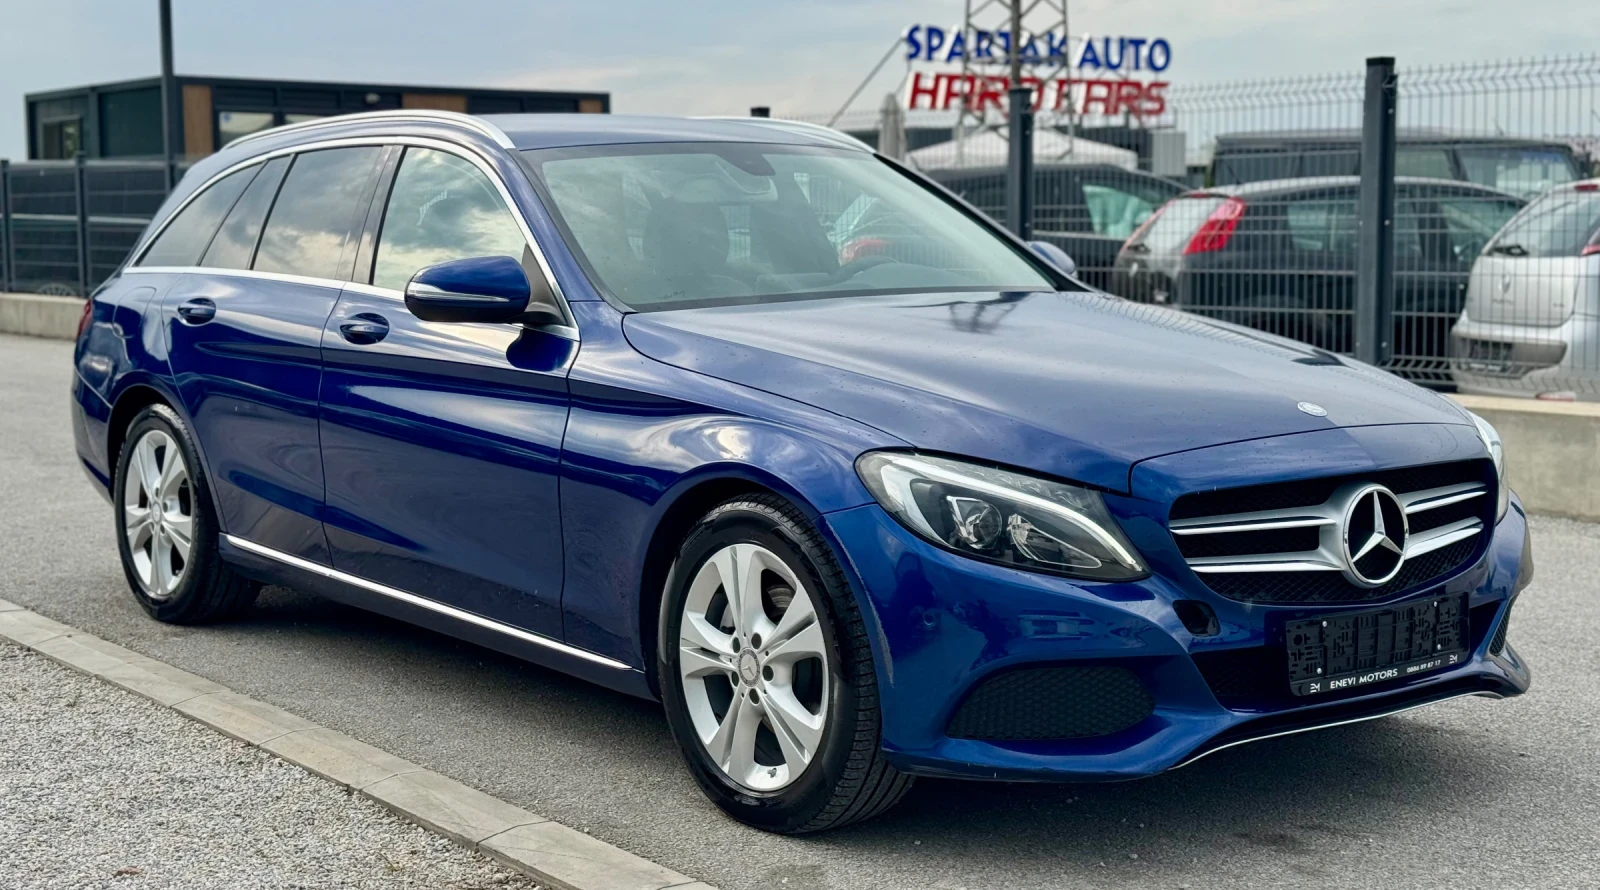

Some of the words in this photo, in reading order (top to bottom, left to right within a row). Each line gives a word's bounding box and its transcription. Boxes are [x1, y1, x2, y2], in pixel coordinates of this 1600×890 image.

[905, 25, 1067, 67] SPARTAK
[1078, 36, 1172, 72] AUTO
[1053, 78, 1170, 123] CARS
[1330, 676, 1356, 689] ENEVI
[1359, 668, 1398, 684] MOTORS
